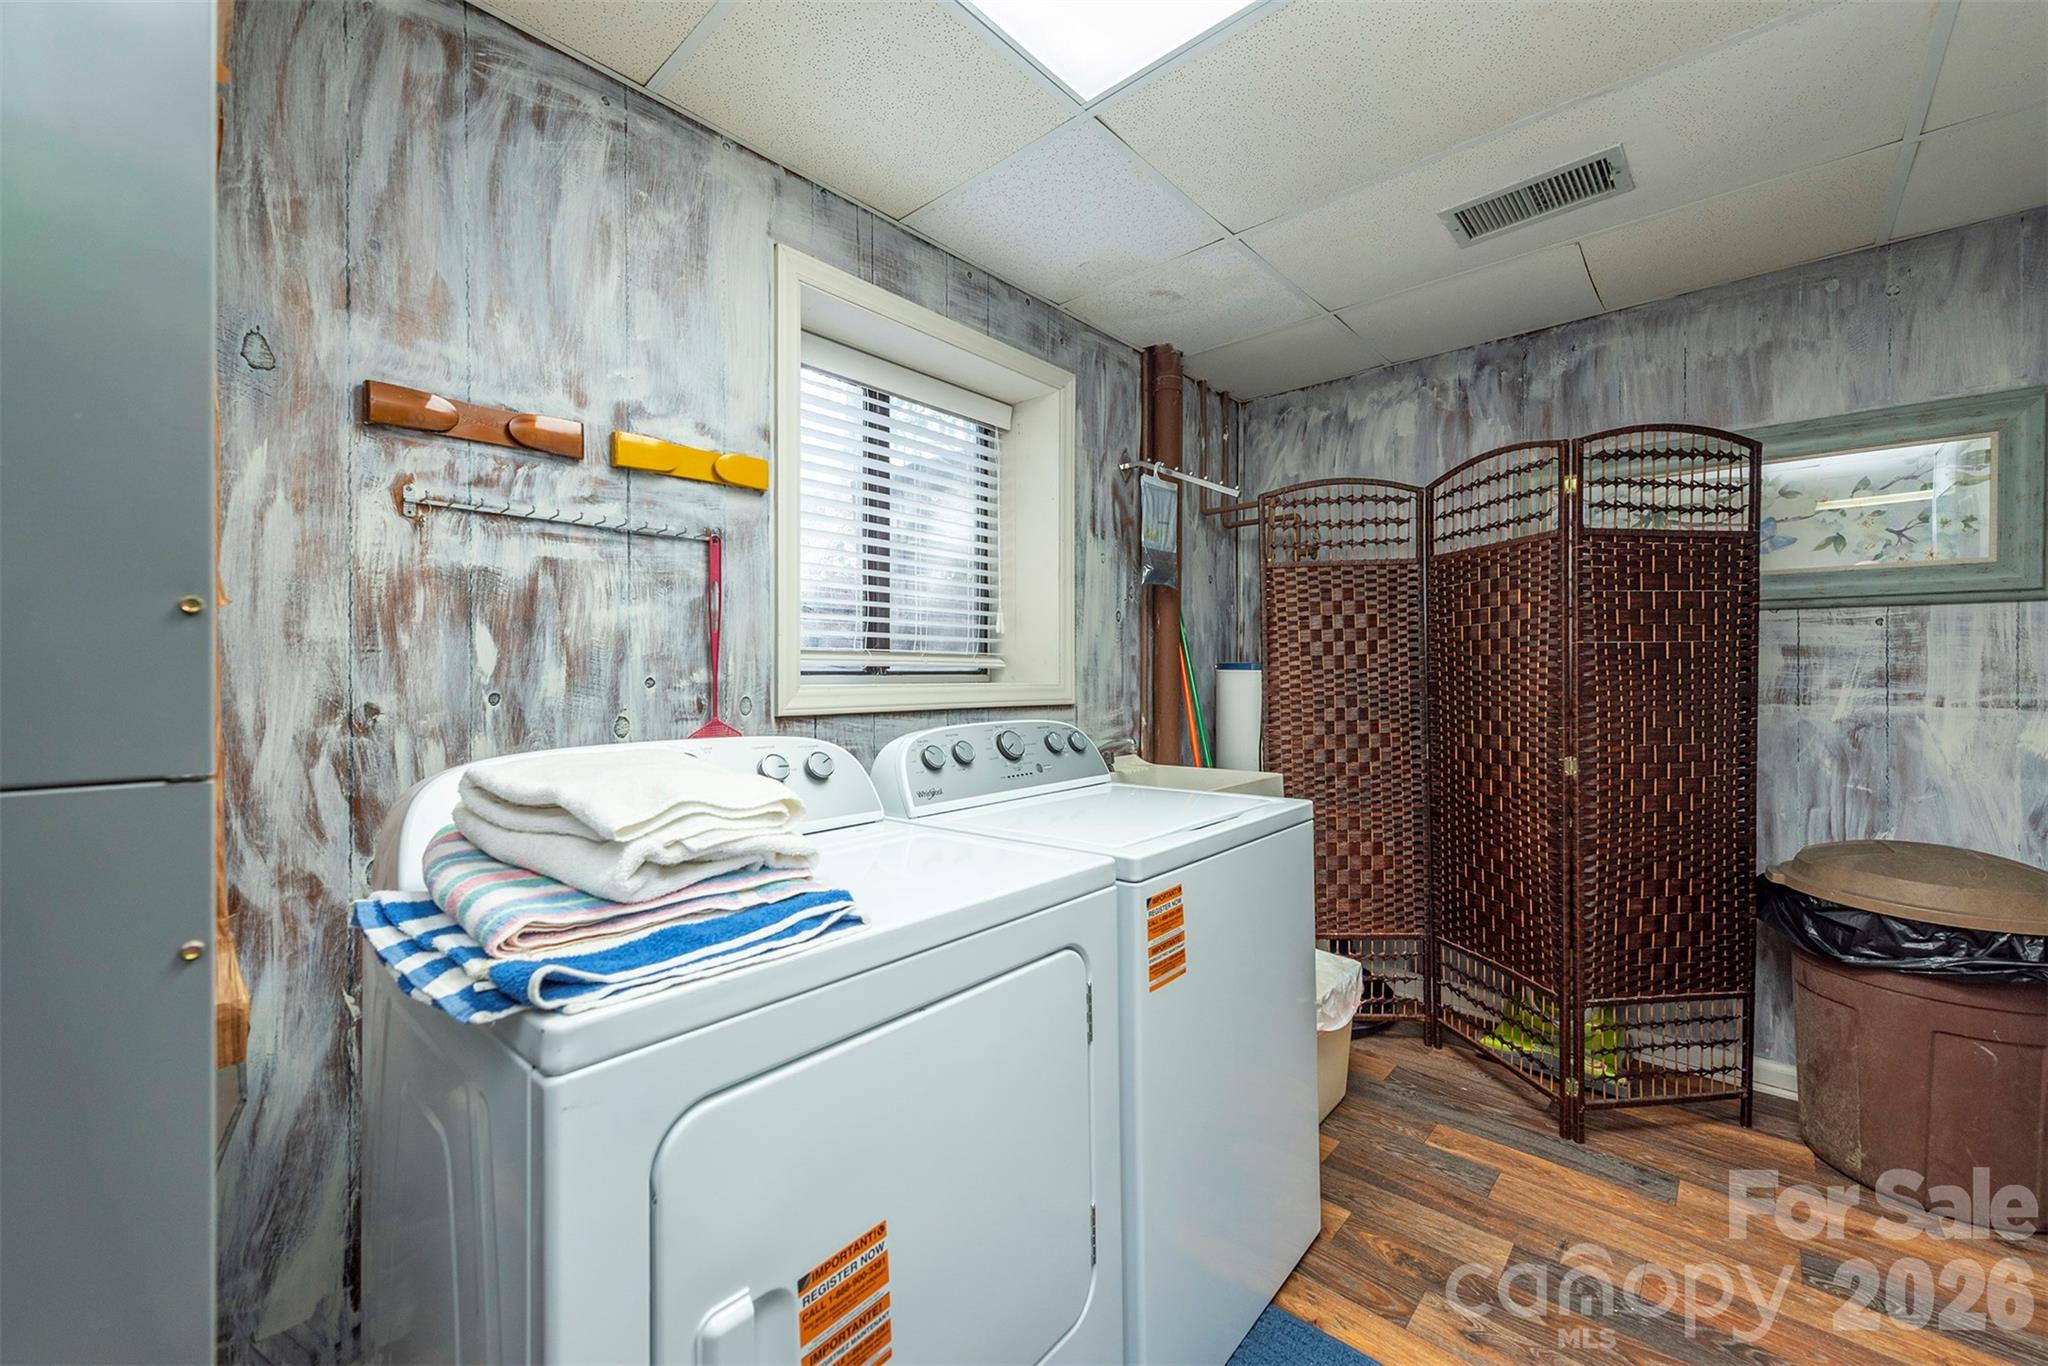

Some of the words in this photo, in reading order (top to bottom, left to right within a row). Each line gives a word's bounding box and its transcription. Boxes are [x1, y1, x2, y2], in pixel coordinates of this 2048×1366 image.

[916, 788, 943, 801] Whirlpool
[802, 1260, 858, 1308] REGISTER
[860, 1241, 886, 1266] NOW
[801, 1301, 826, 1324] CALL
